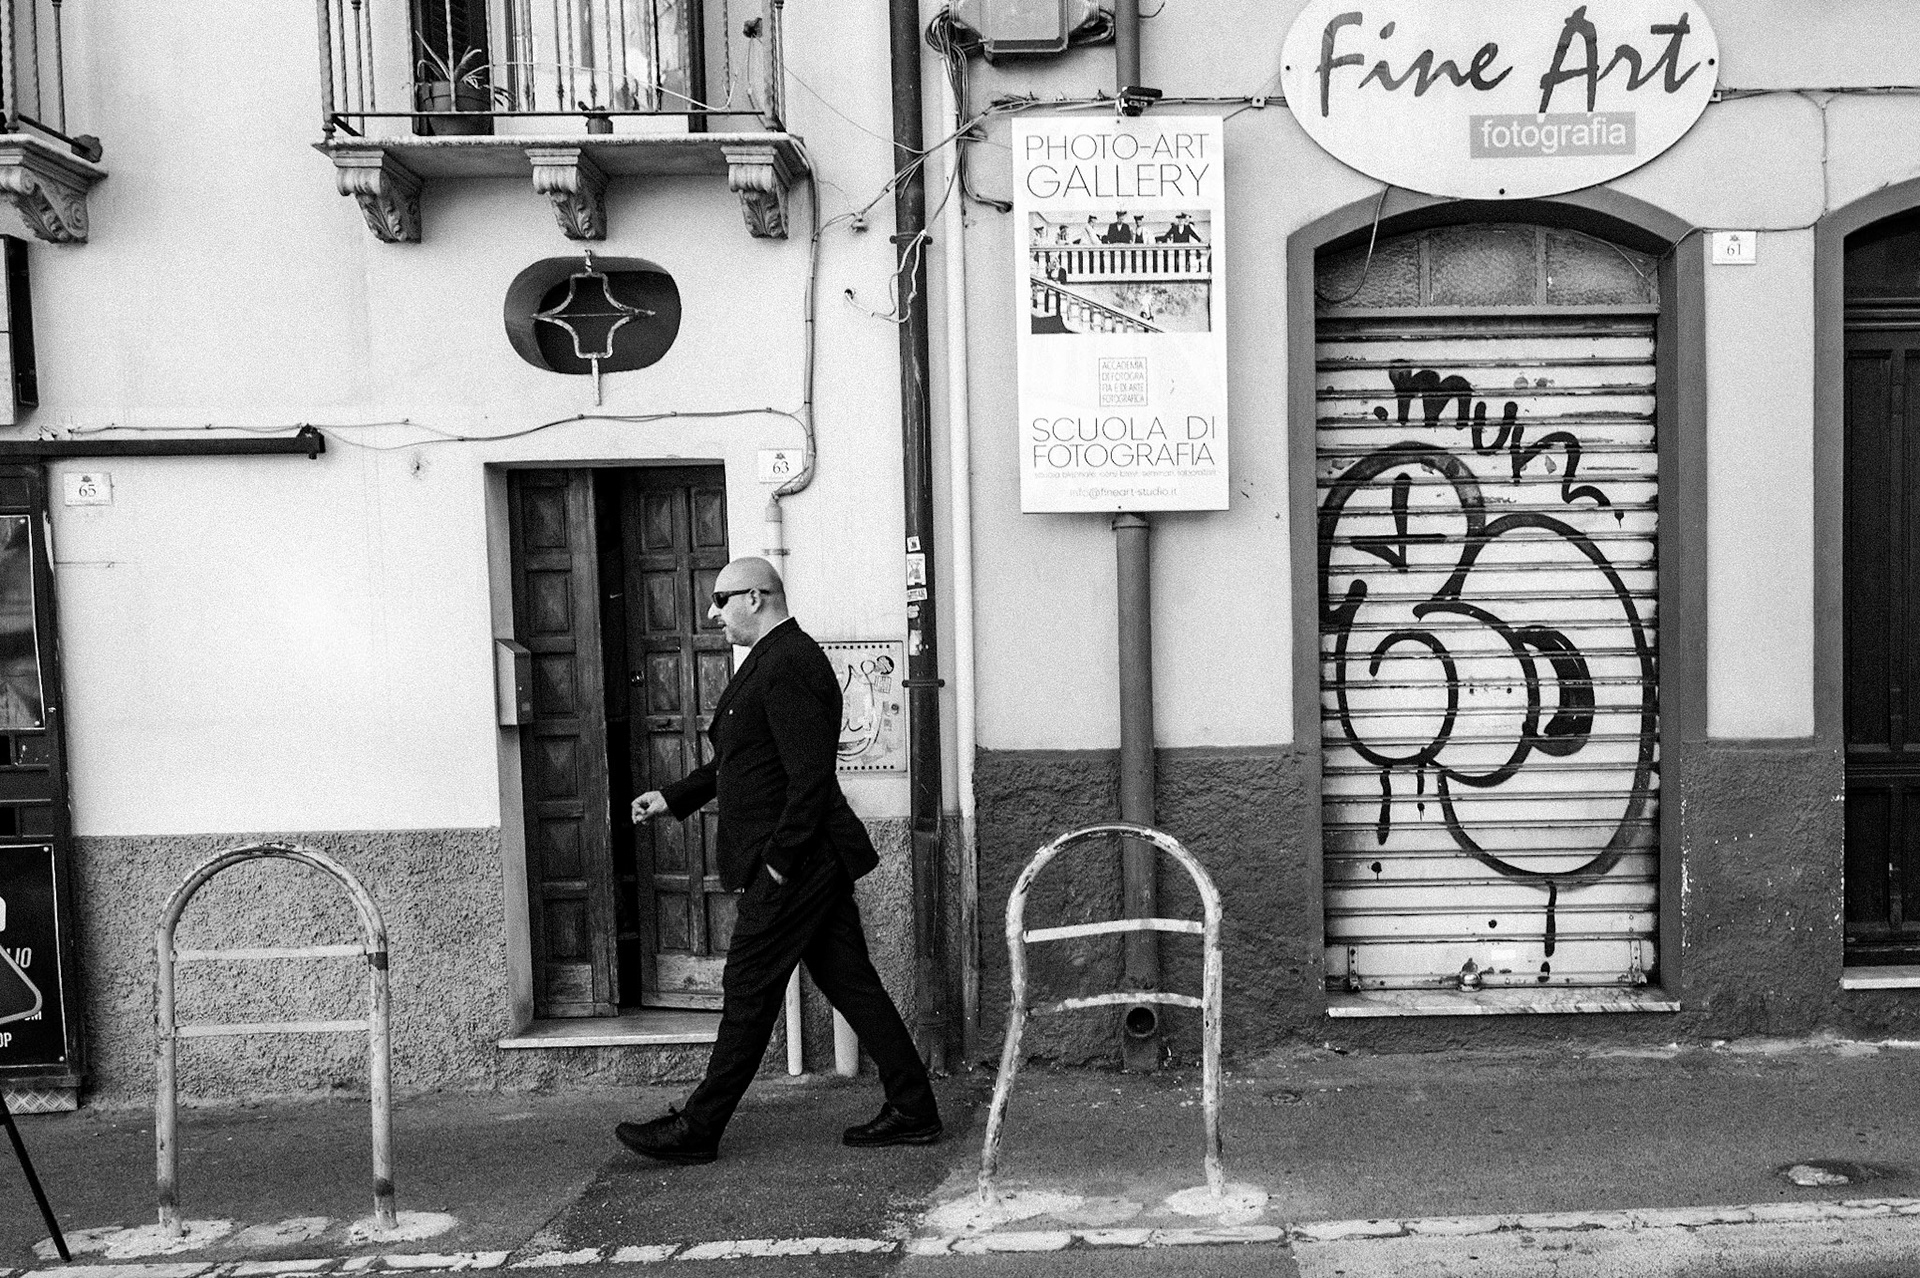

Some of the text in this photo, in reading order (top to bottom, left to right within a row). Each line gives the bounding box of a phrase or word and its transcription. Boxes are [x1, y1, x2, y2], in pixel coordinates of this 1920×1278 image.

[1315, 5, 1701, 118] Fine Art
[1026, 133, 1210, 161] PHOTO-ART
[1481, 117, 1627, 154] fotografia
[1026, 163, 1210, 199] GALLERY
[1726, 243, 1741, 256] 61
[1032, 415, 1216, 442] SCUOLA DI
[772, 460, 790, 474] 63
[1033, 442, 1216, 468] FOTOGRAFIA
[78, 484, 97, 498] 65
[6, 947, 32, 968] IO
